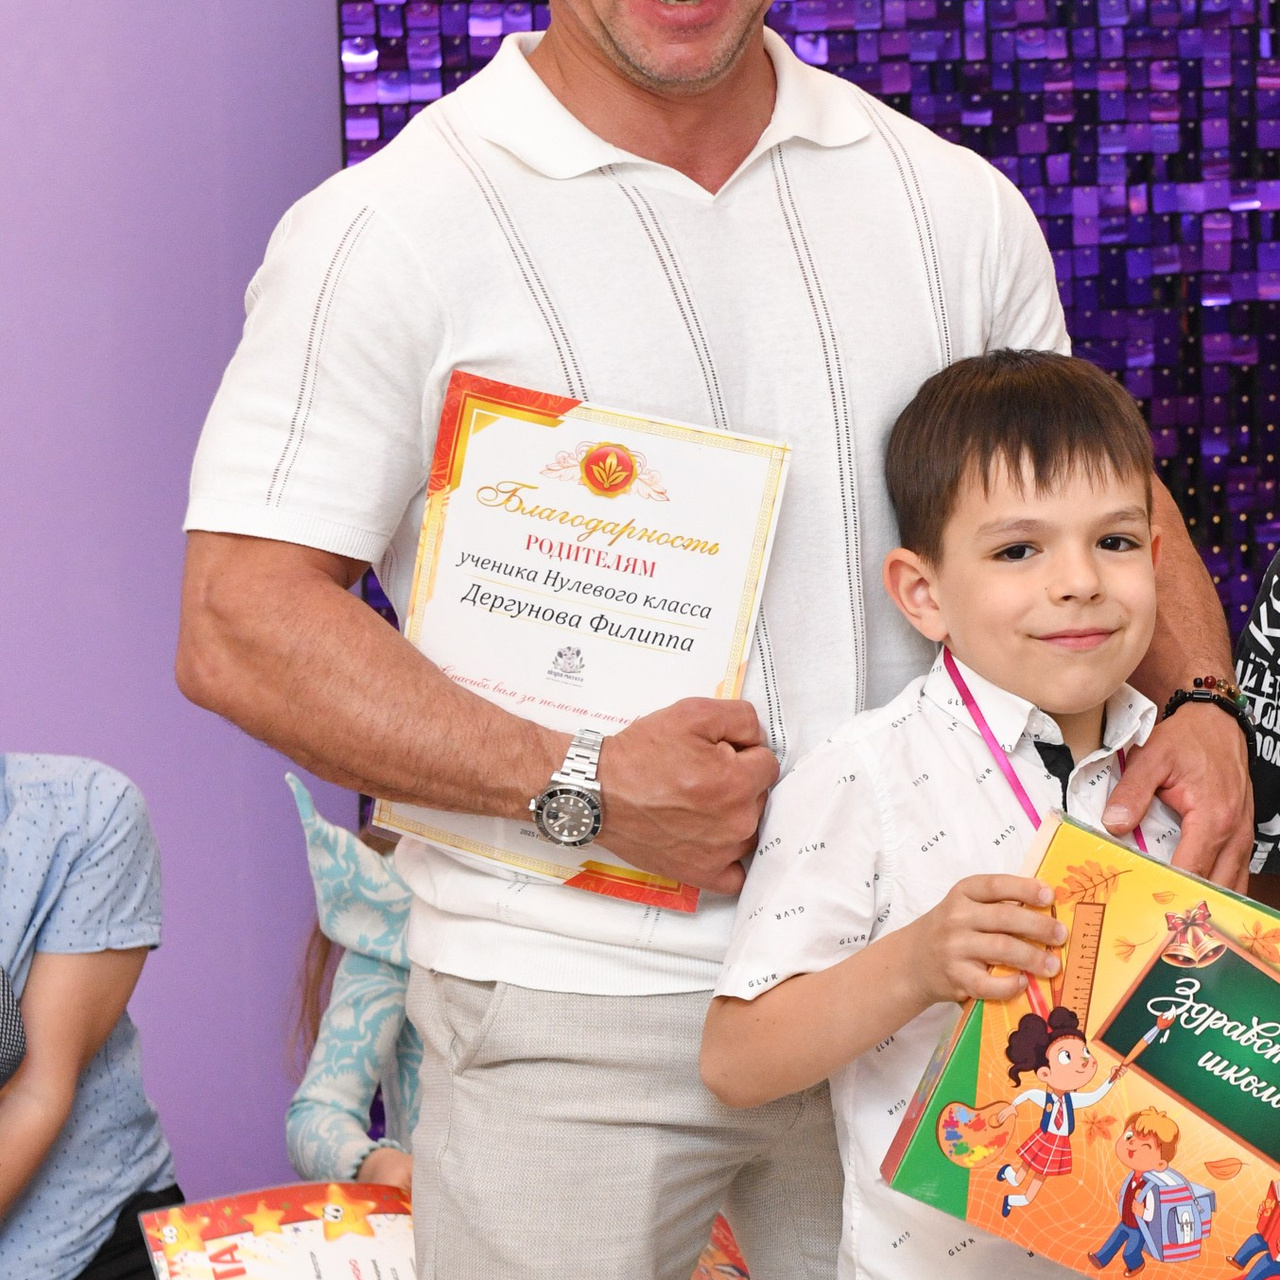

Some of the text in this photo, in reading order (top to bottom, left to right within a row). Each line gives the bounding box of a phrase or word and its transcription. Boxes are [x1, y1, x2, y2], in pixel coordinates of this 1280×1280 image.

[476, 479, 720, 556] Благодарность
[455, 550, 713, 619] ученика Нулевого класса
[524, 533, 657, 578] РОДИТЕЛЯМ
[460, 582, 695, 652] Дергунова Филиппа
[493, 681, 518, 698] вам
[518, 693, 535, 705] за
